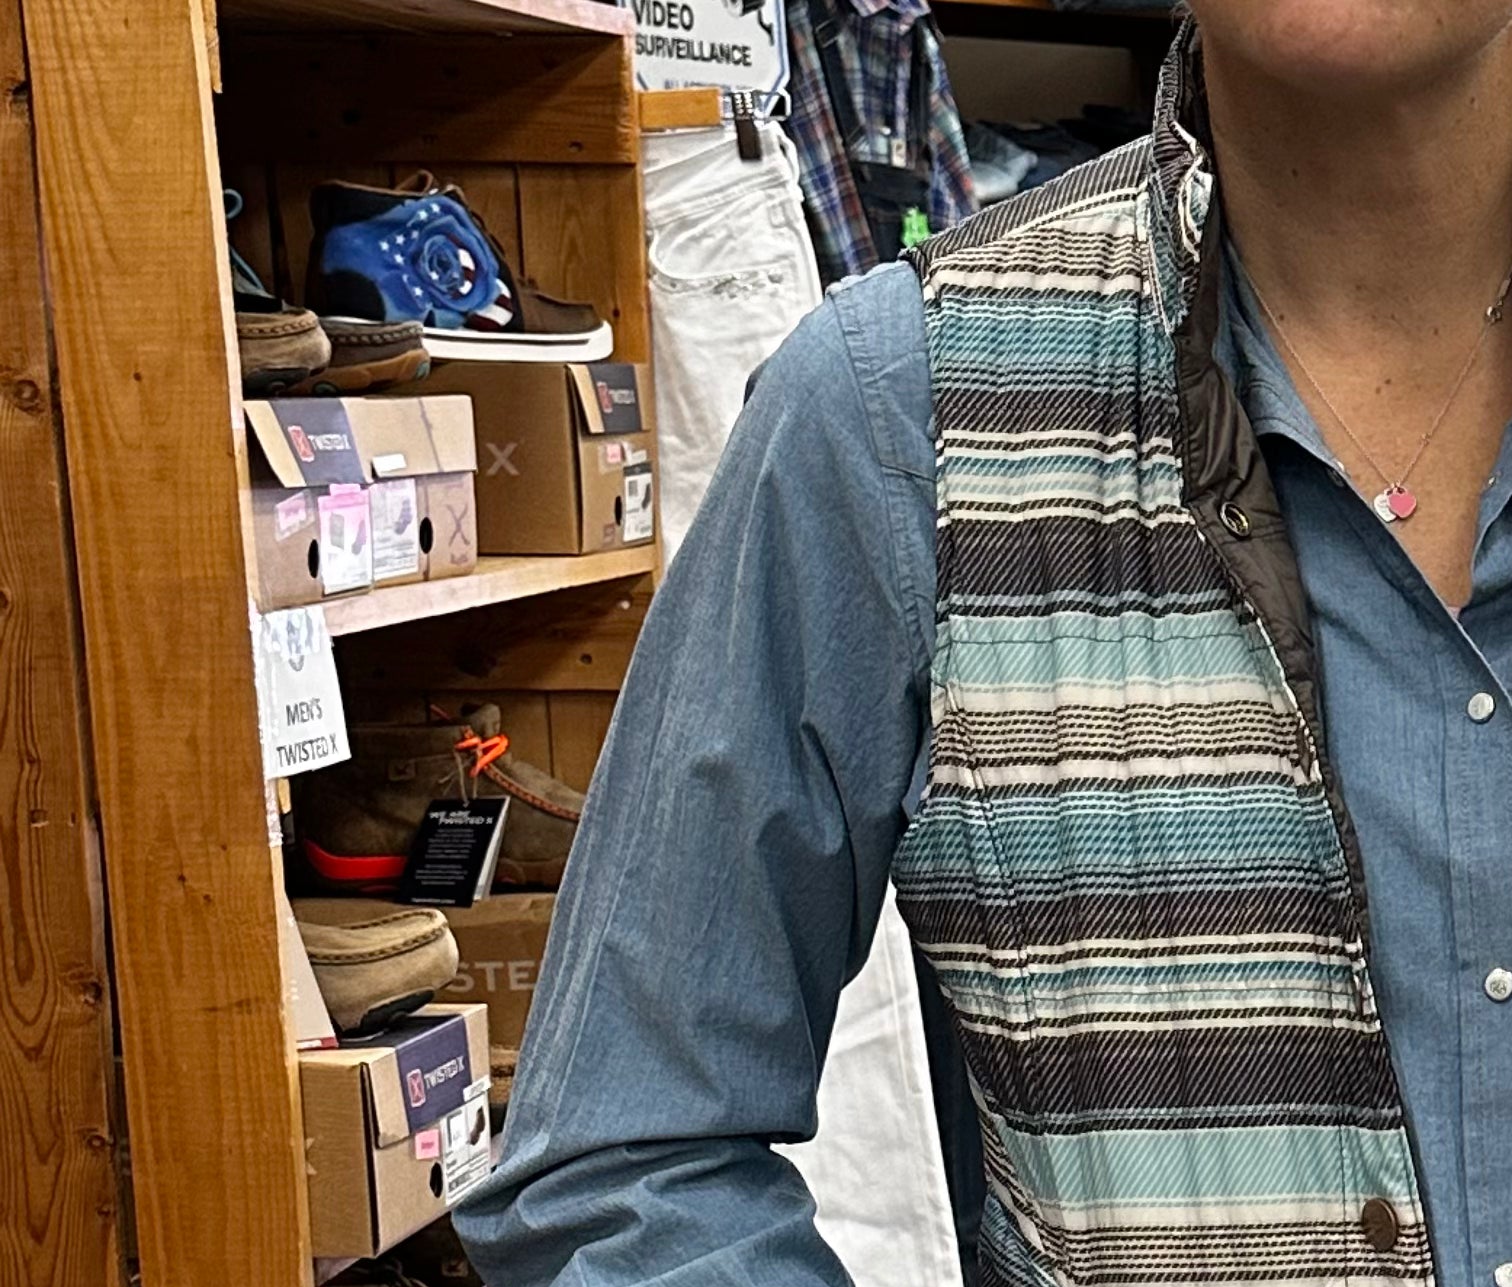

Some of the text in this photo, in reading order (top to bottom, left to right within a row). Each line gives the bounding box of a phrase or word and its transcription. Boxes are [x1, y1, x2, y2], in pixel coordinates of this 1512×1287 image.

[634, 0, 694, 31] VIDEO
[635, 37, 752, 66] SURVEILLANCE
[286, 697, 323, 726] MEN'S
[276, 733, 339, 767] TWISTED X
